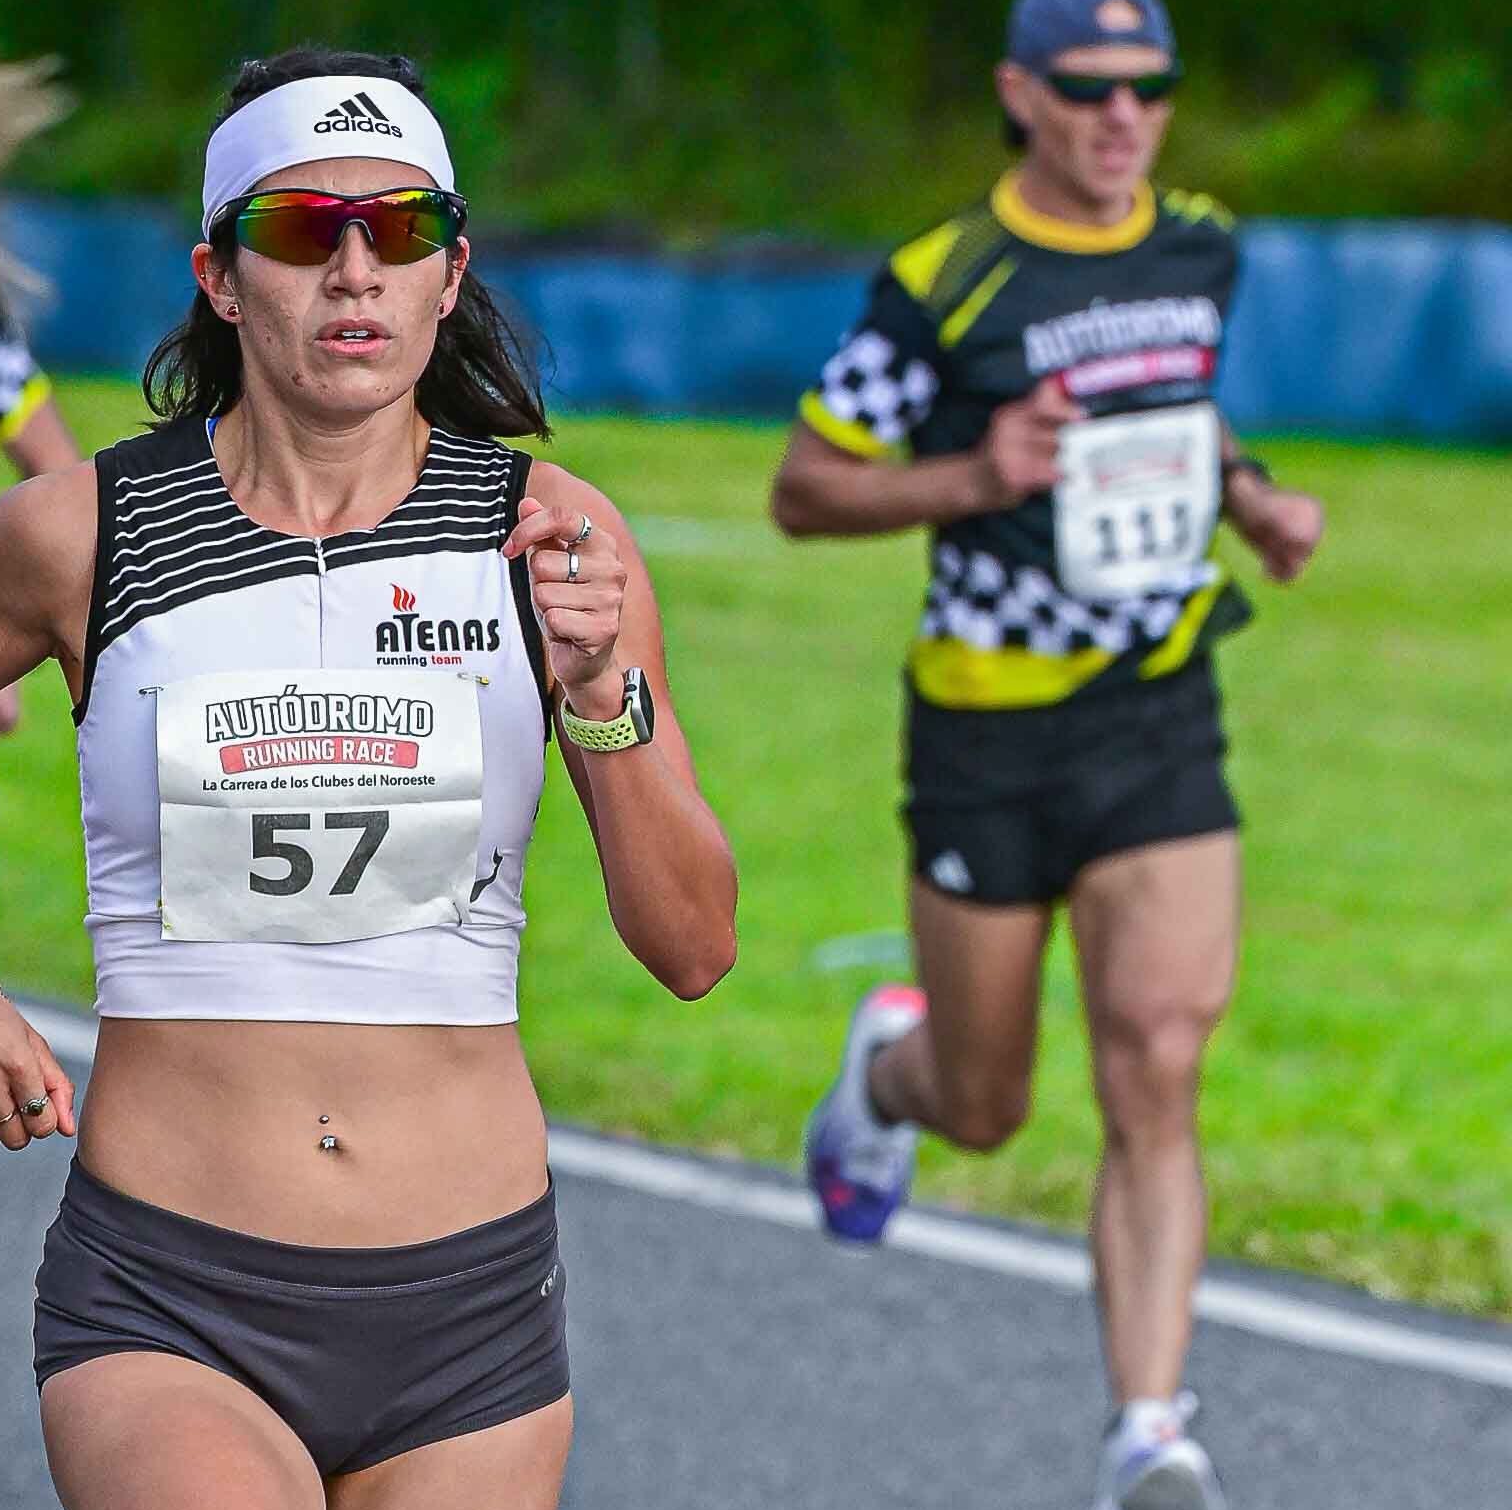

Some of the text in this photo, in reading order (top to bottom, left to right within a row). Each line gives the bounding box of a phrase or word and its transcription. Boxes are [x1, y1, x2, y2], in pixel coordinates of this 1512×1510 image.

[313, 114, 403, 139] adidas
[375, 612, 501, 653] ATENAS
[376, 654, 463, 667] running team
[206, 684, 434, 743] AUTÓDROMO
[243, 738, 396, 769] RUNNING RACE
[202, 773, 436, 791] La Carrera de los Clubes del Noroeste
[249, 810, 389, 896] 57
